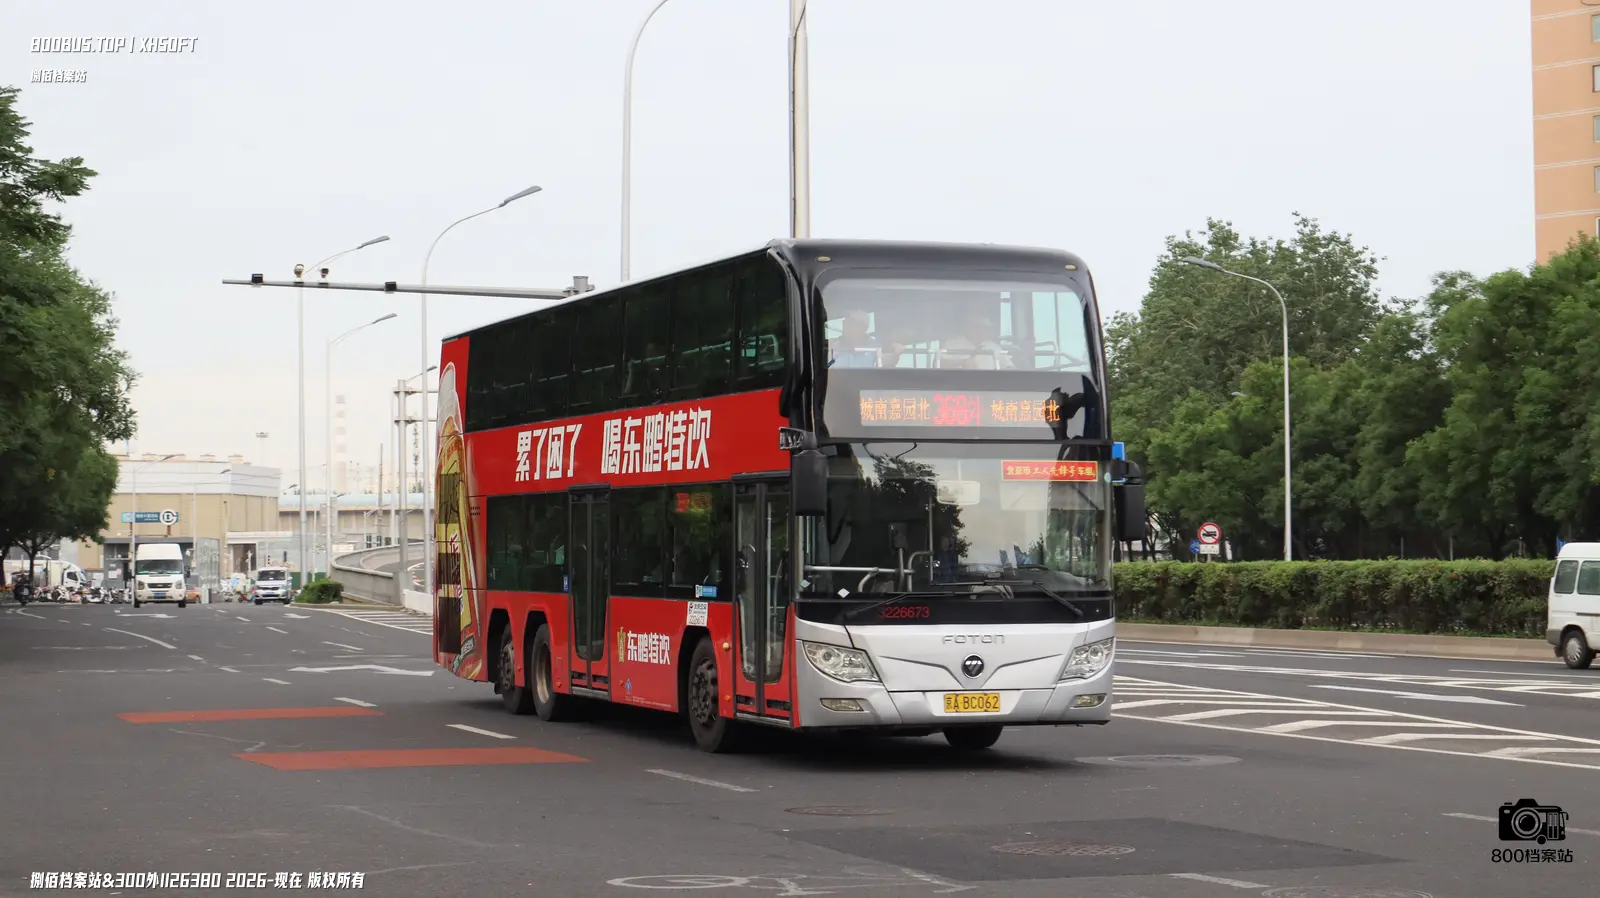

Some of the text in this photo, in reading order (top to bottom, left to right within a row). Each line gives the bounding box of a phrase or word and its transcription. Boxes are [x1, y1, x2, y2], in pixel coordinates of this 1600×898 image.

[860, 397, 931, 421] 城南嘉园北
[991, 399, 1061, 422] 城南嘉园北
[514, 406, 712, 483] 累了困了 喝东鹏特饮
[879, 606, 930, 619] 3226673
[627, 630, 671, 665] 东鹏特饮
[942, 634, 1005, 644] FOTON
